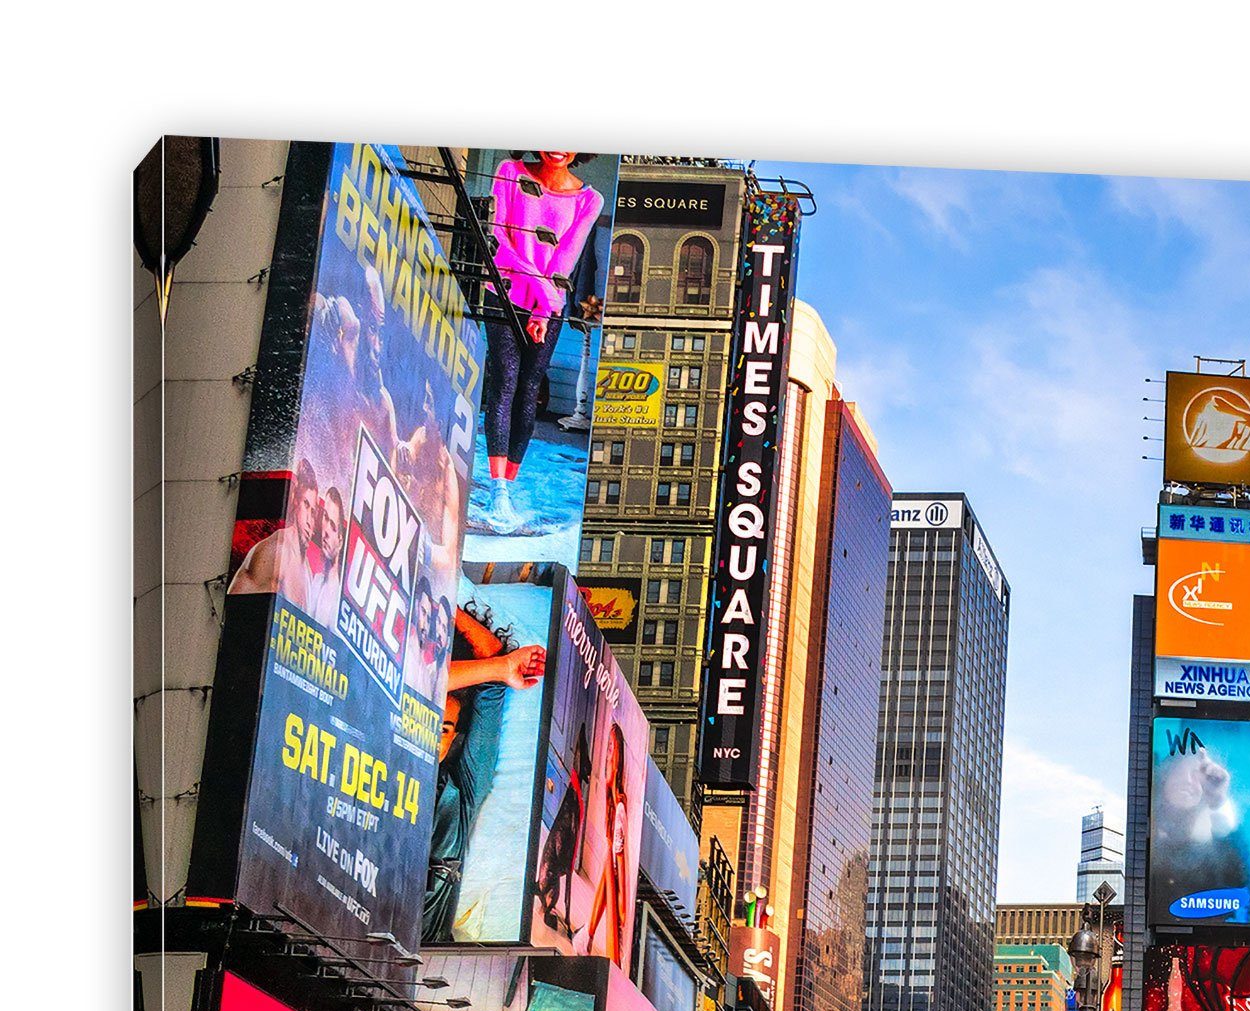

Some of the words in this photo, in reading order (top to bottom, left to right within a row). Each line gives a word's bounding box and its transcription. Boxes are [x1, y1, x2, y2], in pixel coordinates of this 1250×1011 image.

[350, 143, 465, 331] JOHNSON
[643, 198, 709, 211] SQUARE
[336, 173, 480, 411] BENAVIDEZ
[741, 244, 786, 437] TIMES
[449, 393, 475, 478] 2
[603, 405, 633, 413] York's
[620, 415, 657, 424] Station
[353, 439, 419, 597] FOX
[348, 536, 408, 653] UFC
[716, 462, 766, 716] SQUARE
[275, 635, 349, 700] McDONALD
[279, 608, 324, 652] FABER
[339, 602, 401, 695] SATURDAY
[564, 604, 598, 690] merry
[1165, 681, 1205, 695] NEWS
[1180, 664, 1250, 685] XINHUA
[281, 712, 337, 787] SAT.
[340, 744, 390, 812] DEC.
[393, 771, 421, 825] 14
[712, 747, 741, 759] NYC
[316, 826, 340, 864] LIVE
[353, 848, 380, 898] FOX
[1180, 897, 1240, 910] SAMSUNG
